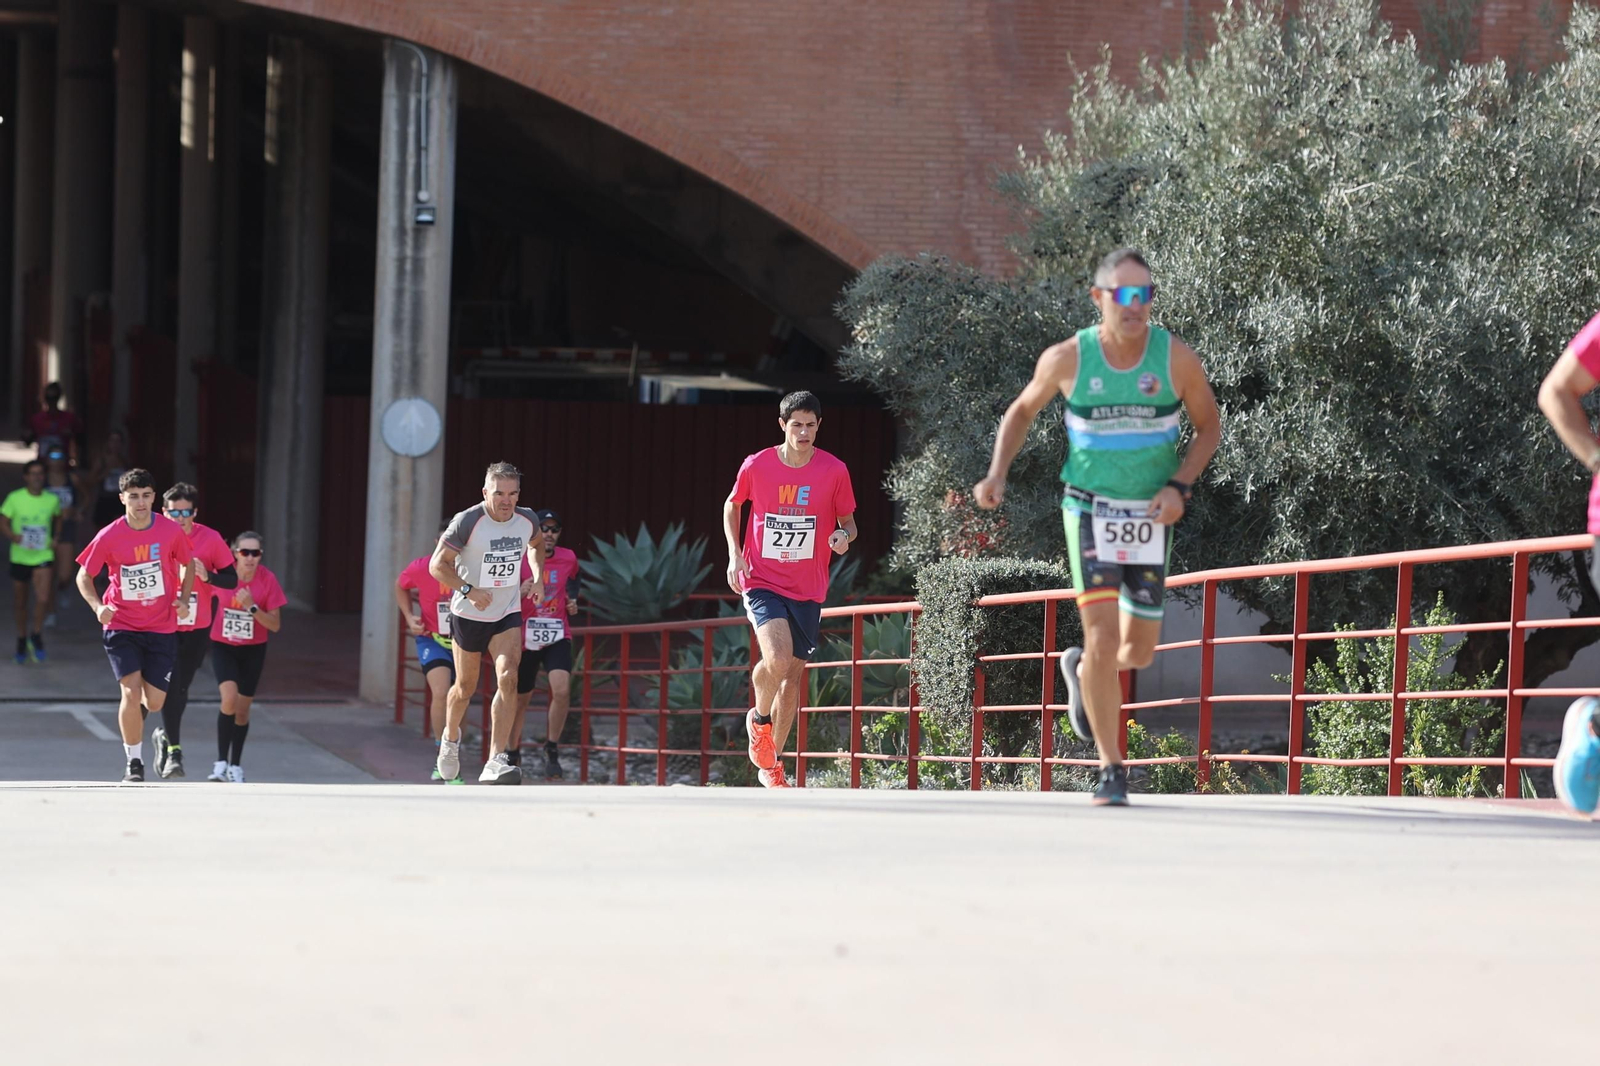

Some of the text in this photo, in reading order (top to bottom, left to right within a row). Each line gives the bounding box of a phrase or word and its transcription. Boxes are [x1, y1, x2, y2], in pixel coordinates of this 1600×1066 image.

[1091, 405, 1157, 419] ATLETISMO
[779, 484, 811, 506] WE
[767, 521, 790, 530] UMA
[1105, 522, 1153, 544] 580
[772, 531, 808, 547] 277
[134, 543, 160, 561] WE
[488, 563, 515, 577] 429
[128, 575, 157, 591] 583
[225, 620, 251, 633] 454
[532, 630, 558, 643] 587
